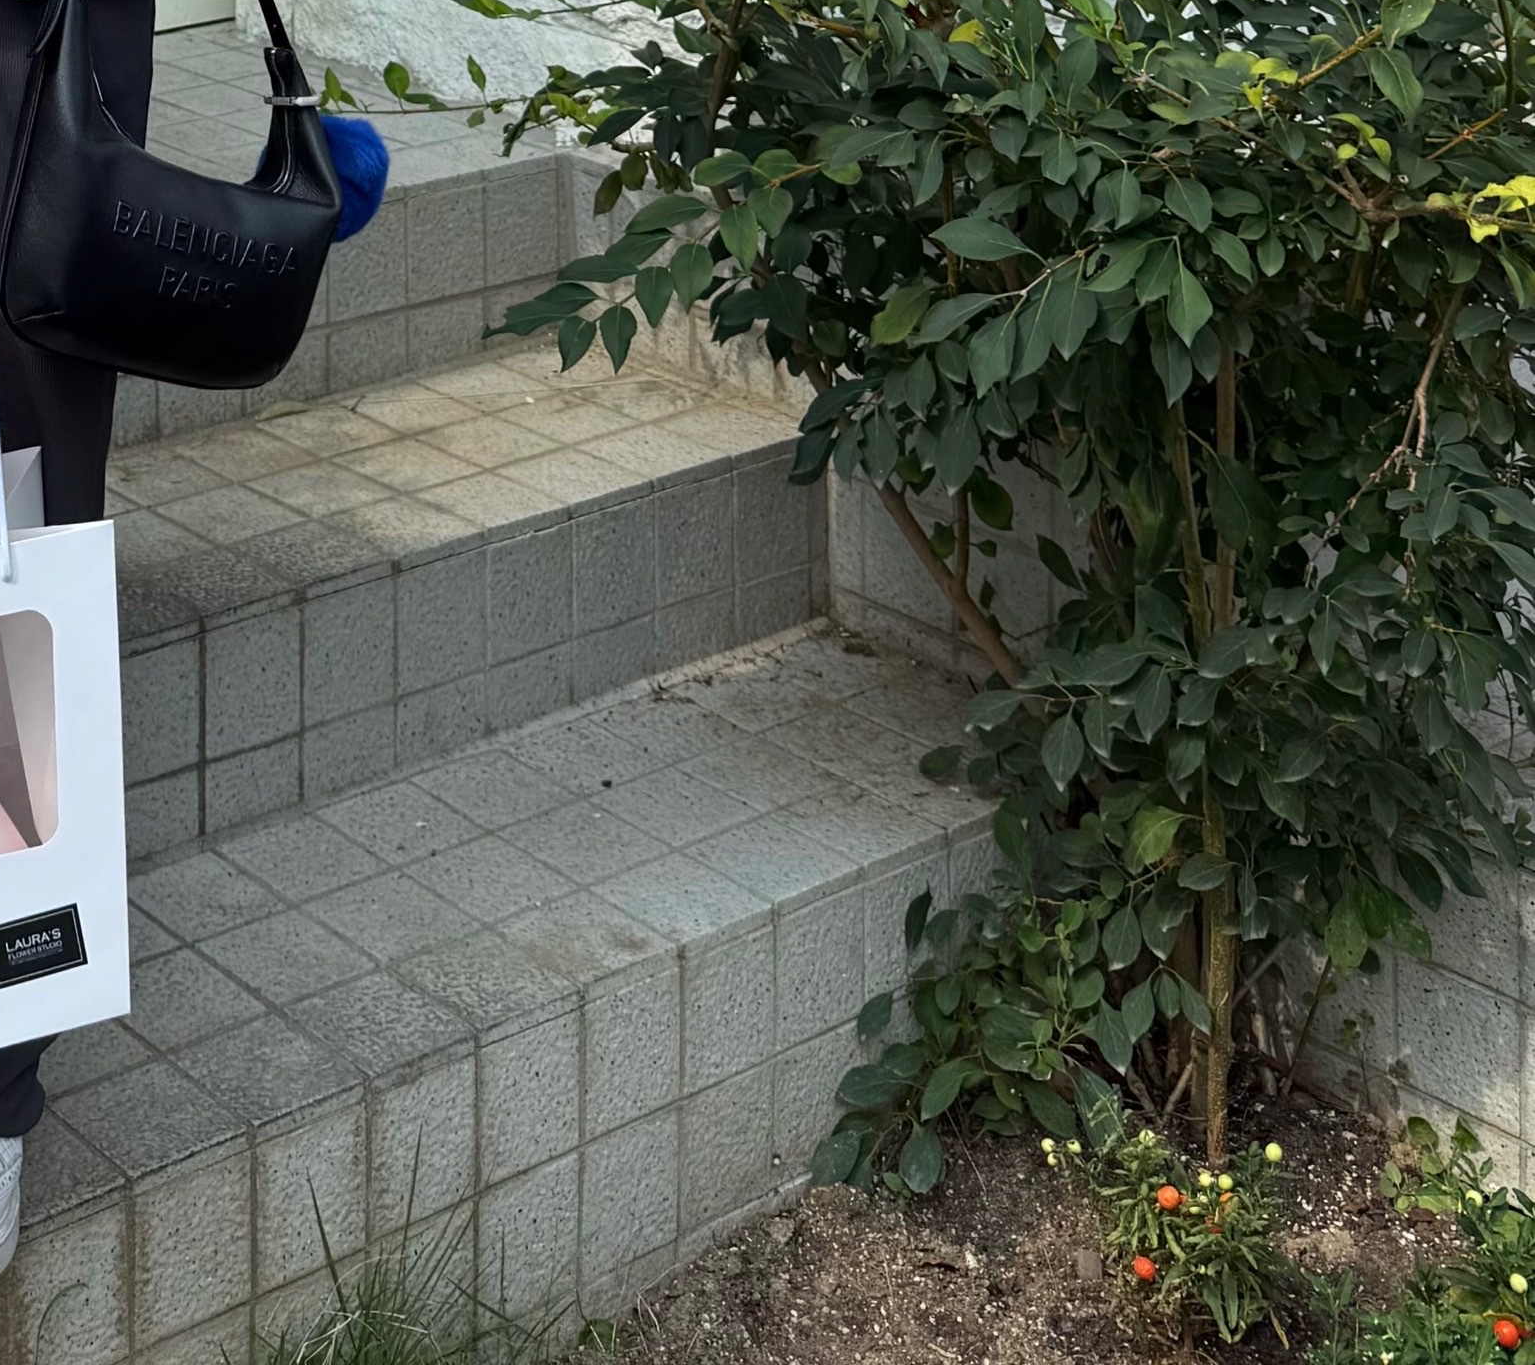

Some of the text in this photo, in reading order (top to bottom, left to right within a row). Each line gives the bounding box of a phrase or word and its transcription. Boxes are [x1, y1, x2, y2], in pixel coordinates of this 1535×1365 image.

[112, 199, 297, 276] BALENCIAGA
[157, 265, 238, 310] PARIS
[5, 927, 62, 953] LAURA'S
